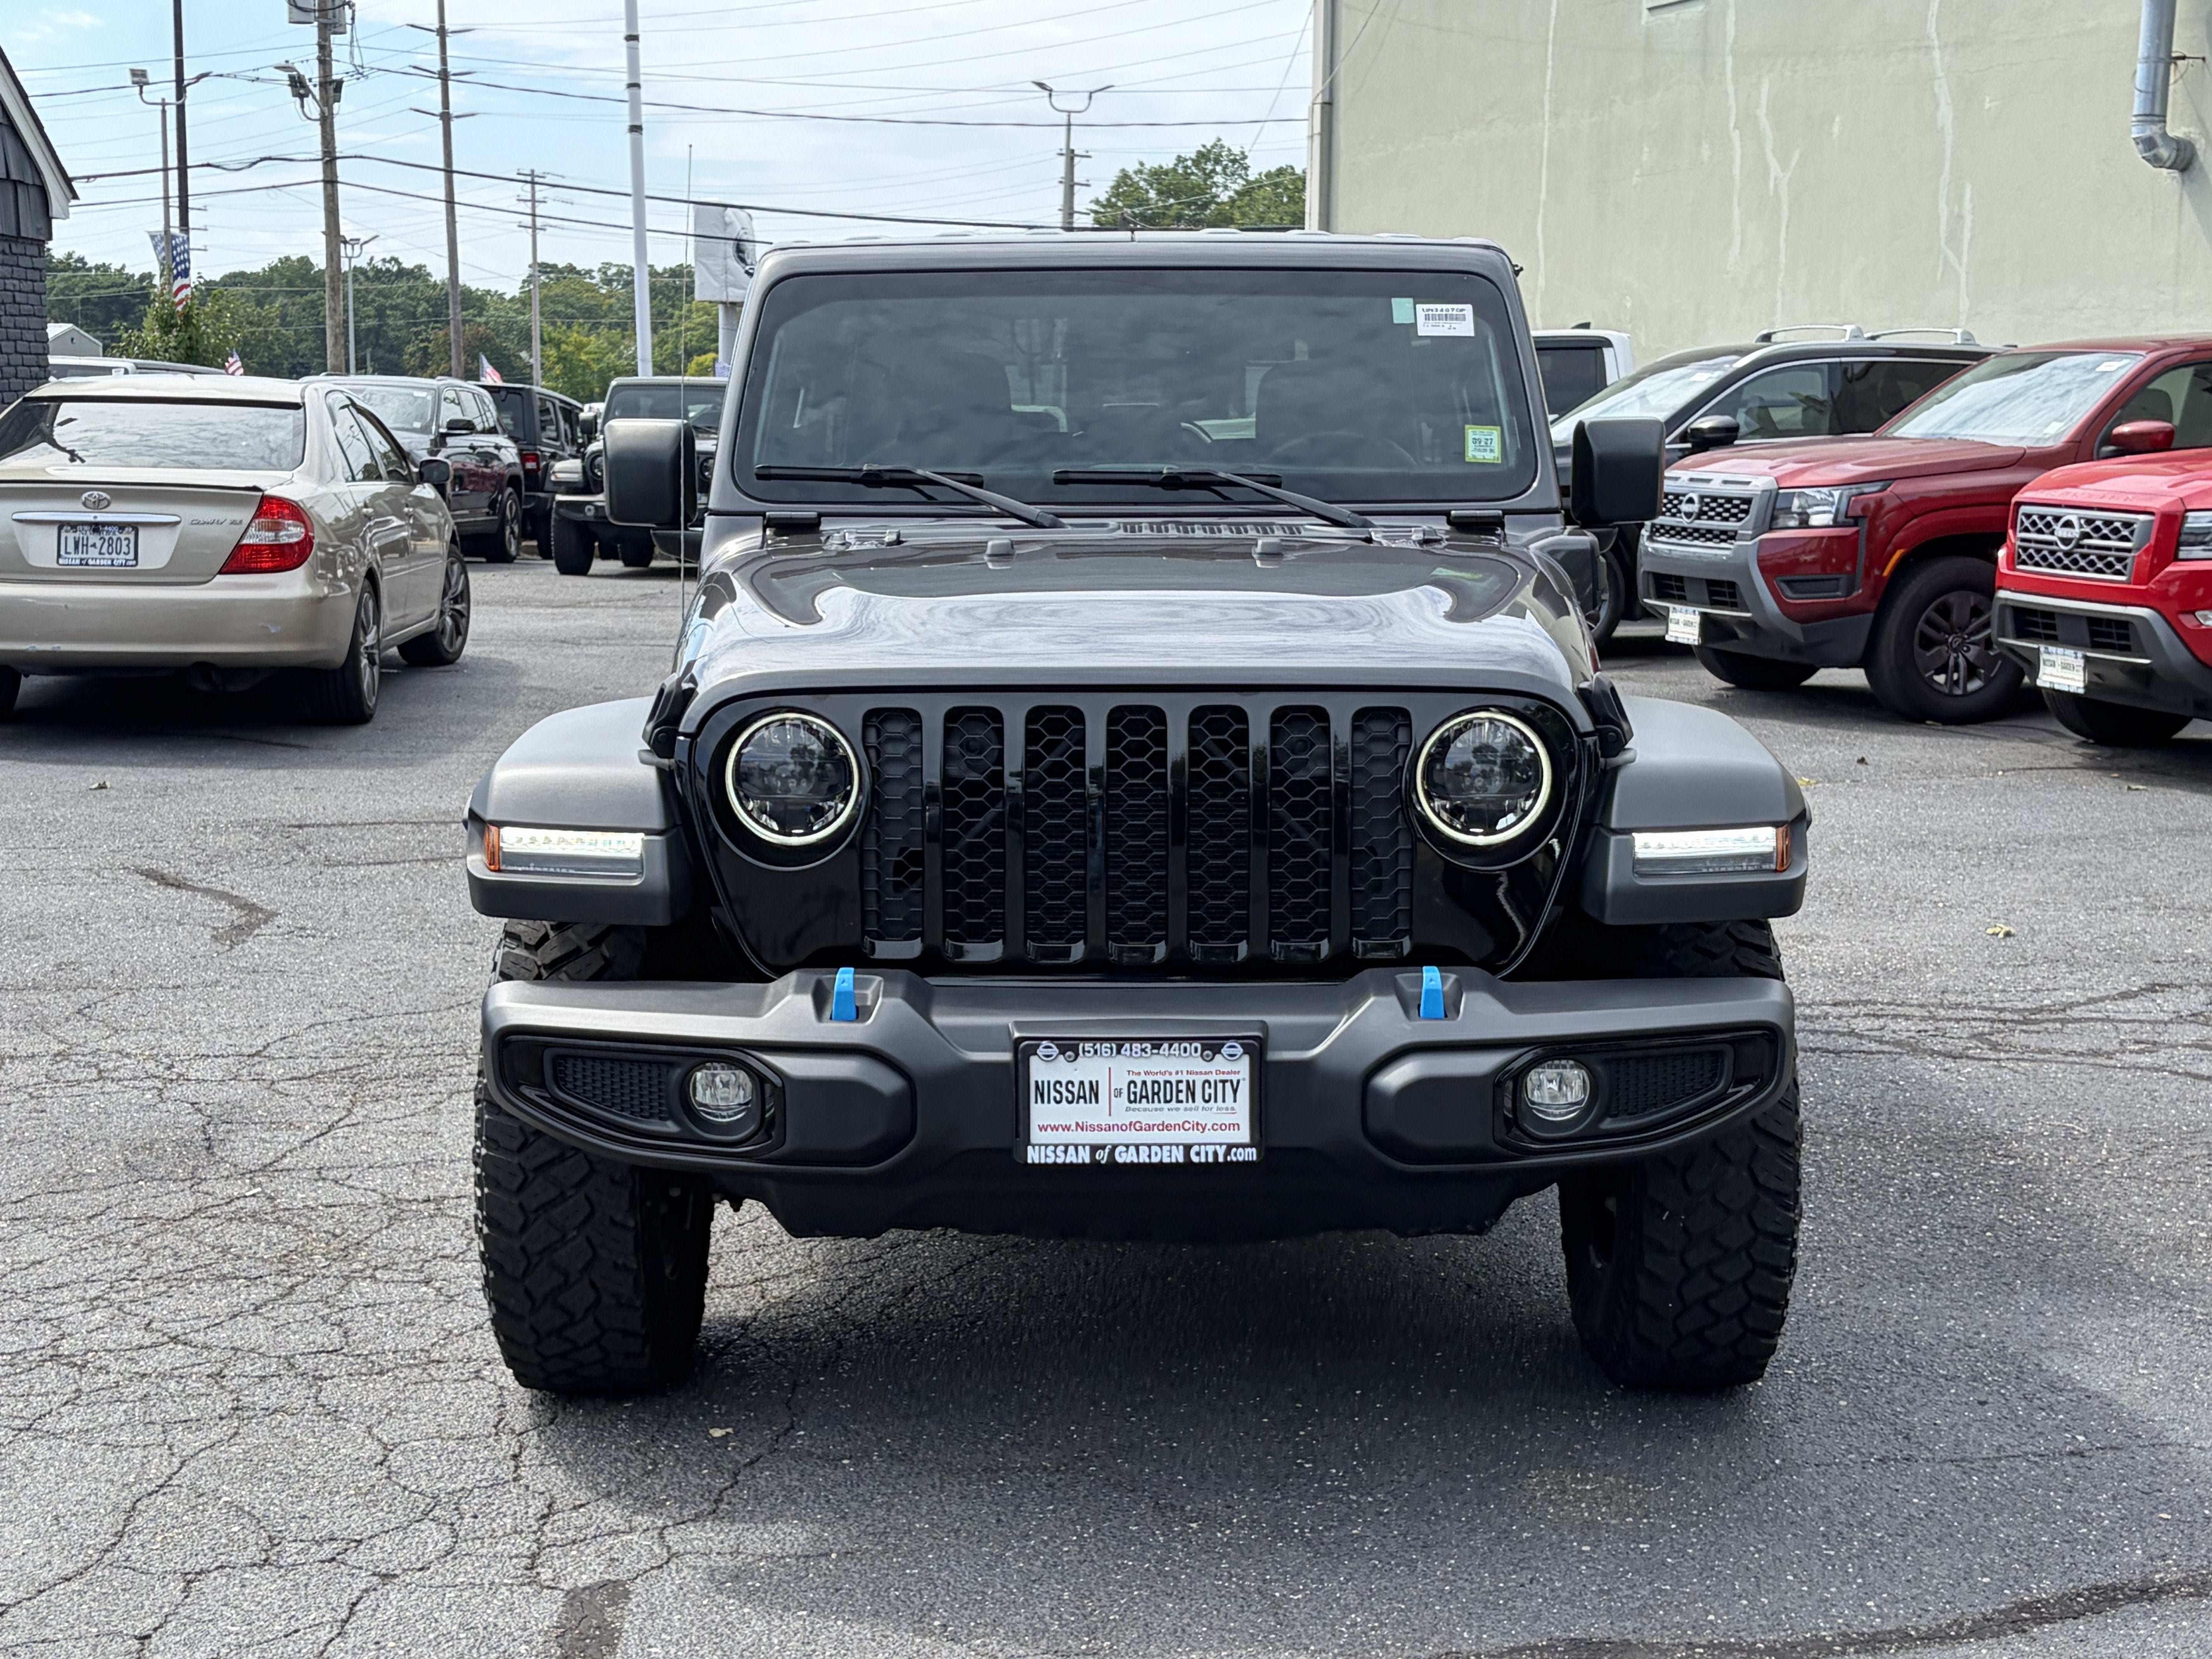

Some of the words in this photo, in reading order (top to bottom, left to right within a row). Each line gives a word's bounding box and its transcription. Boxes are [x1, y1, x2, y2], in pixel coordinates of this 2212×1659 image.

[98, 537, 131, 555] 2803
[1079, 1043, 1116, 1057] (516)
[1121, 1043, 1201, 1057] 483-4400
[1034, 1080, 1099, 1104] NISSAN
[1114, 1088, 1123, 1098] OF
[1127, 1080, 1195, 1104] GARDEN
[1202, 1079, 1240, 1103] CITY
[1038, 1120, 1240, 1133] www.NissanofGardenCity.com
[1027, 1145, 1090, 1163] NISSAN
[1096, 1145, 1111, 1164] of
[1115, 1145, 1183, 1163] GARDEN
